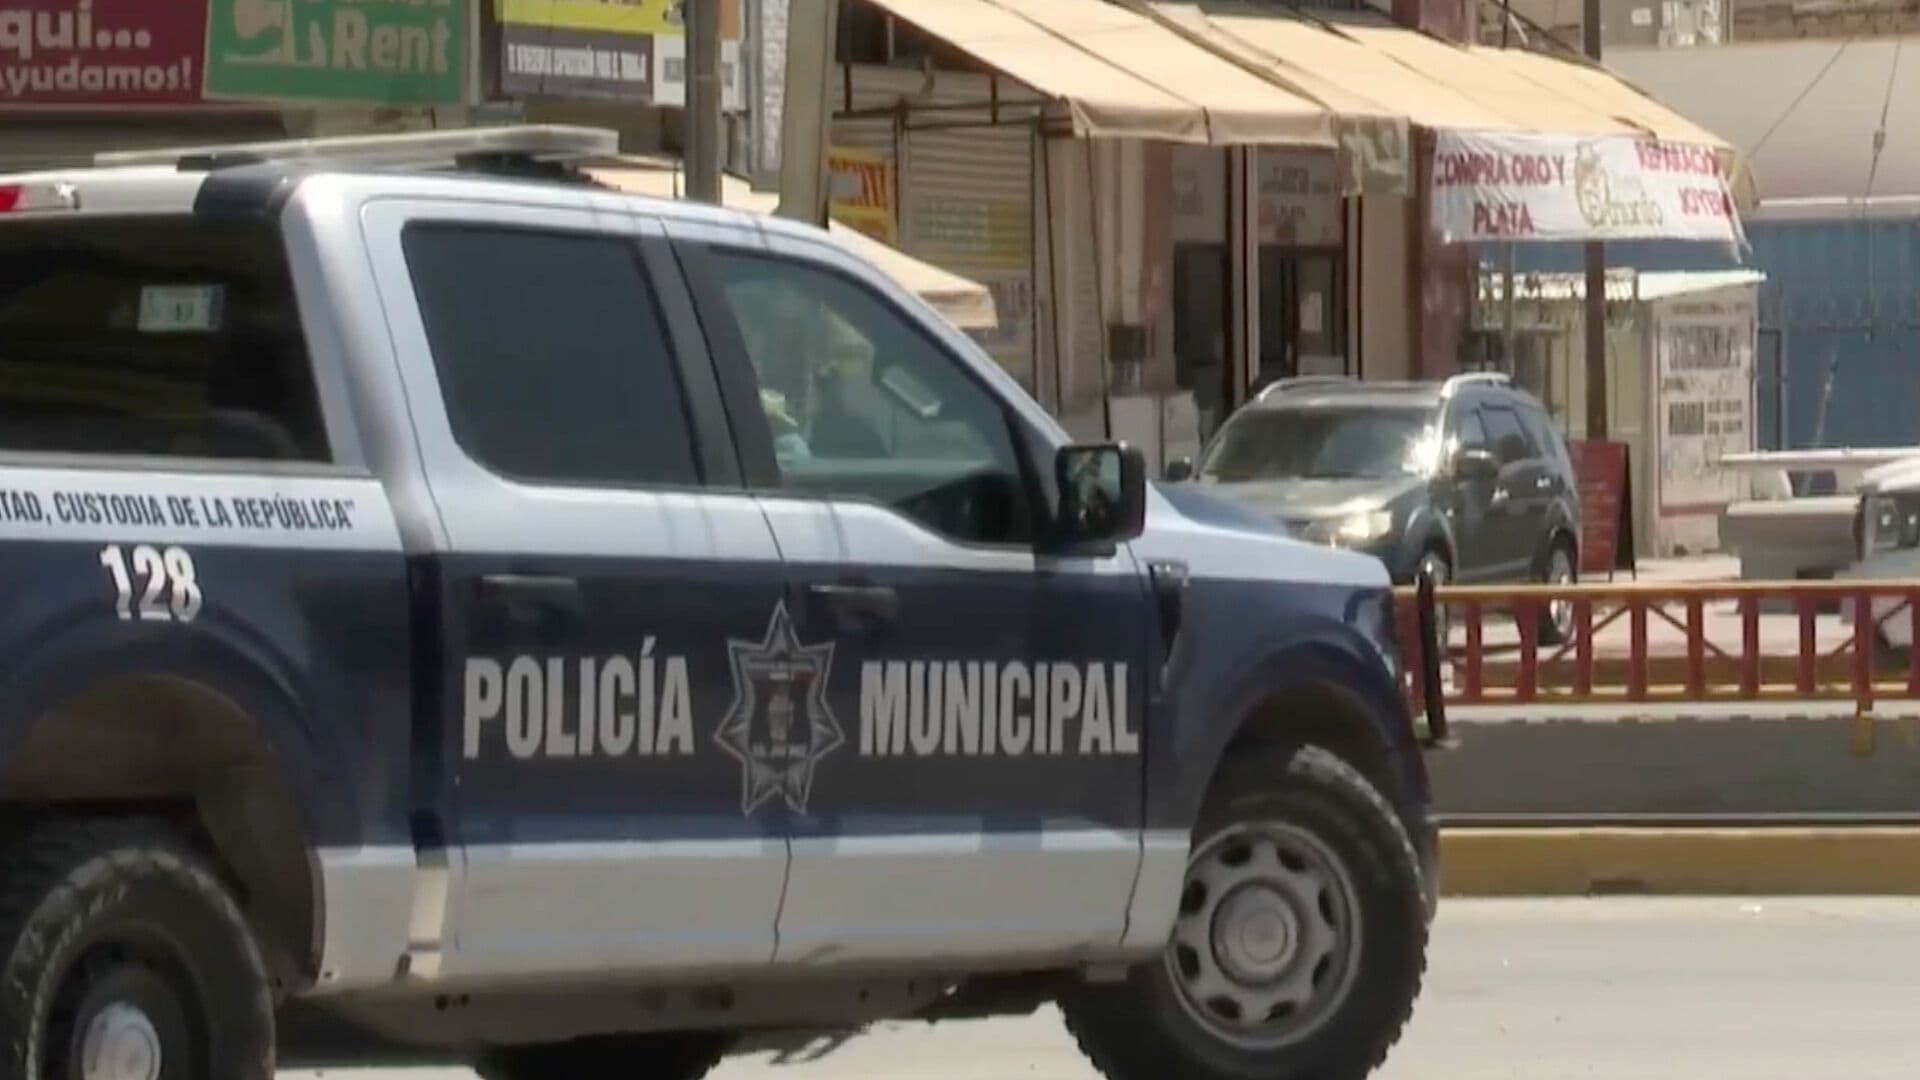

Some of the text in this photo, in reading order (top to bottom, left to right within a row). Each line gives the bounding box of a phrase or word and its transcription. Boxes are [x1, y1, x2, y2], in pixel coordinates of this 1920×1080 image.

[331, 8, 450, 74] Rent
[0, 55, 192, 97] yudamos!
[1511, 153, 1552, 185] ORO
[1552, 153, 1565, 187] Y
[1472, 201, 1535, 234] PLATA
[0, 490, 51, 527] TAD,
[53, 491, 166, 528] CUSTODIA
[167, 495, 200, 528] DE
[202, 497, 233, 529] LA
[100, 543, 203, 623] 128
[463, 636, 1140, 759] POLICÍA MUNICIPAL
